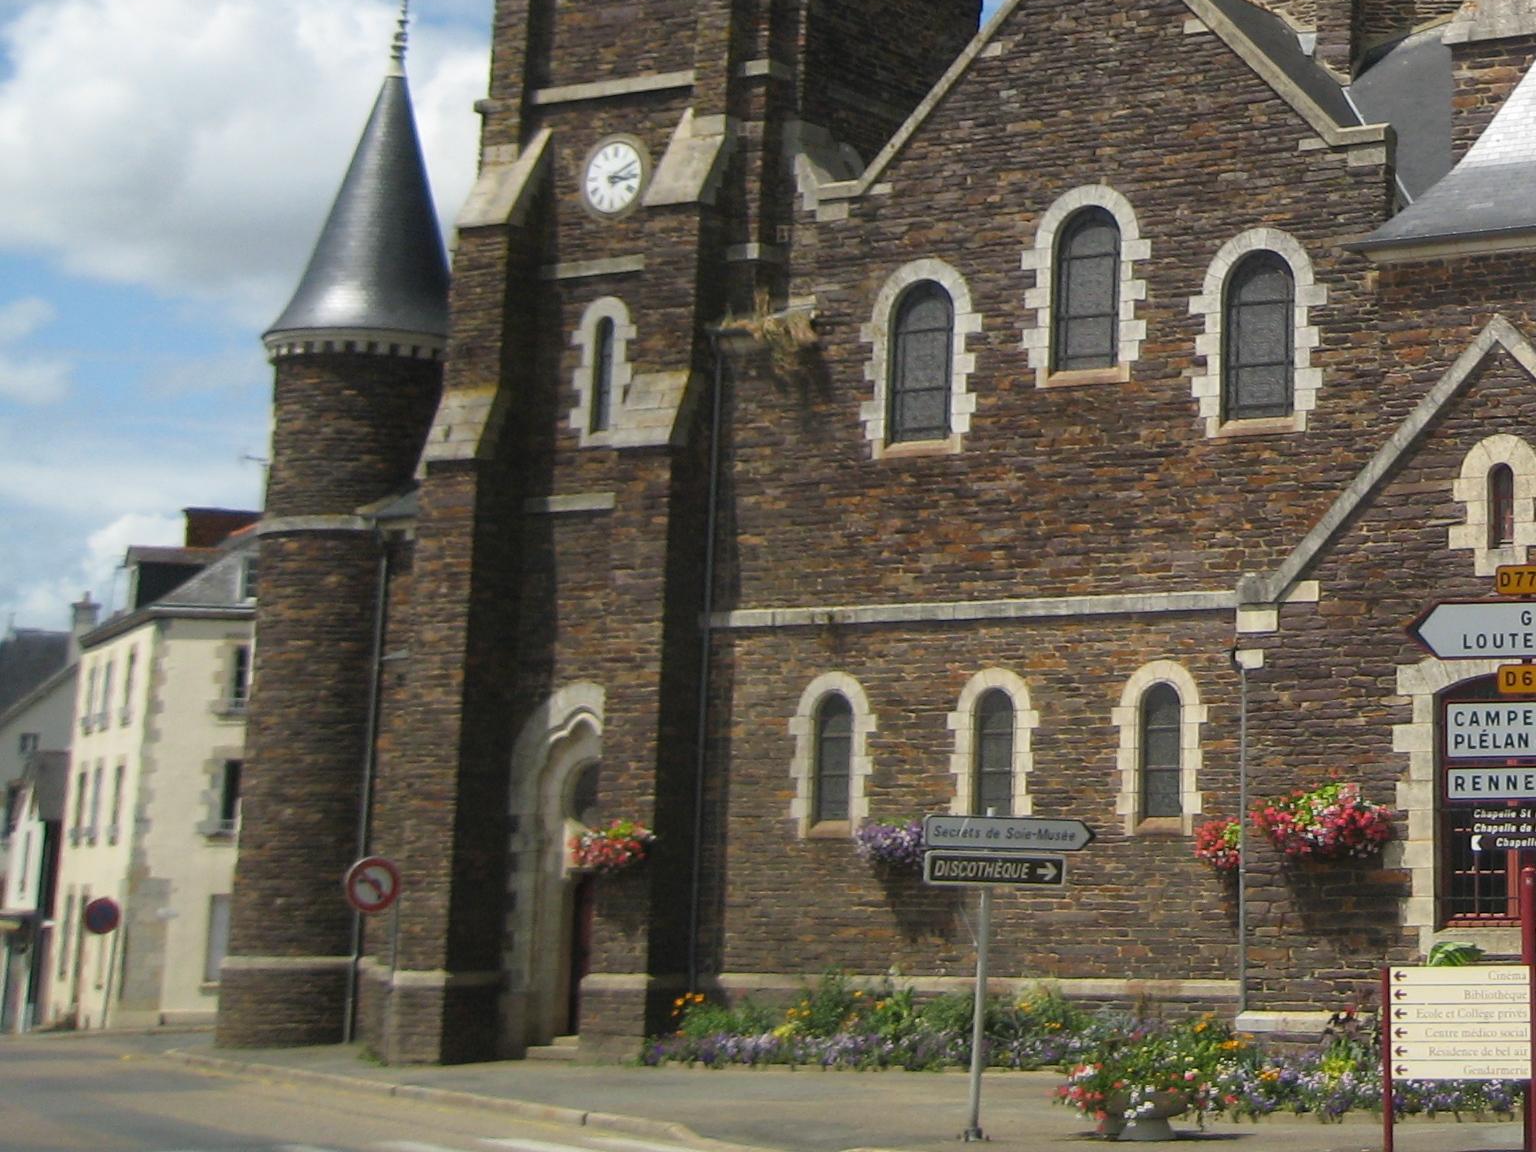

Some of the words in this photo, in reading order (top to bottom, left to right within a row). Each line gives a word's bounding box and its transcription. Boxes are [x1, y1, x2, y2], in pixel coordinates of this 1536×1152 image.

[1453, 728, 1530, 750] PLÉLAN
[1473, 808, 1517, 820] Chapelle
[1519, 808, 1532, 819] St
[932, 824, 981, 839] Secrets
[985, 826, 1000, 840] de
[1473, 823, 1517, 834] Chapelle
[1519, 823, 1532, 833] de
[933, 859, 1030, 880] DISCOTHÈQUE
[1446, 1009, 1455, 1019] et
[1424, 1027, 1458, 1038] Centre
[1499, 1027, 1528, 1038] social
[1480, 1046, 1494, 1057] de
[1495, 1046, 1511, 1057] bel
[1512, 1046, 1529, 1057] air
[1463, 1064, 1529, 1076] Gendarmerie
